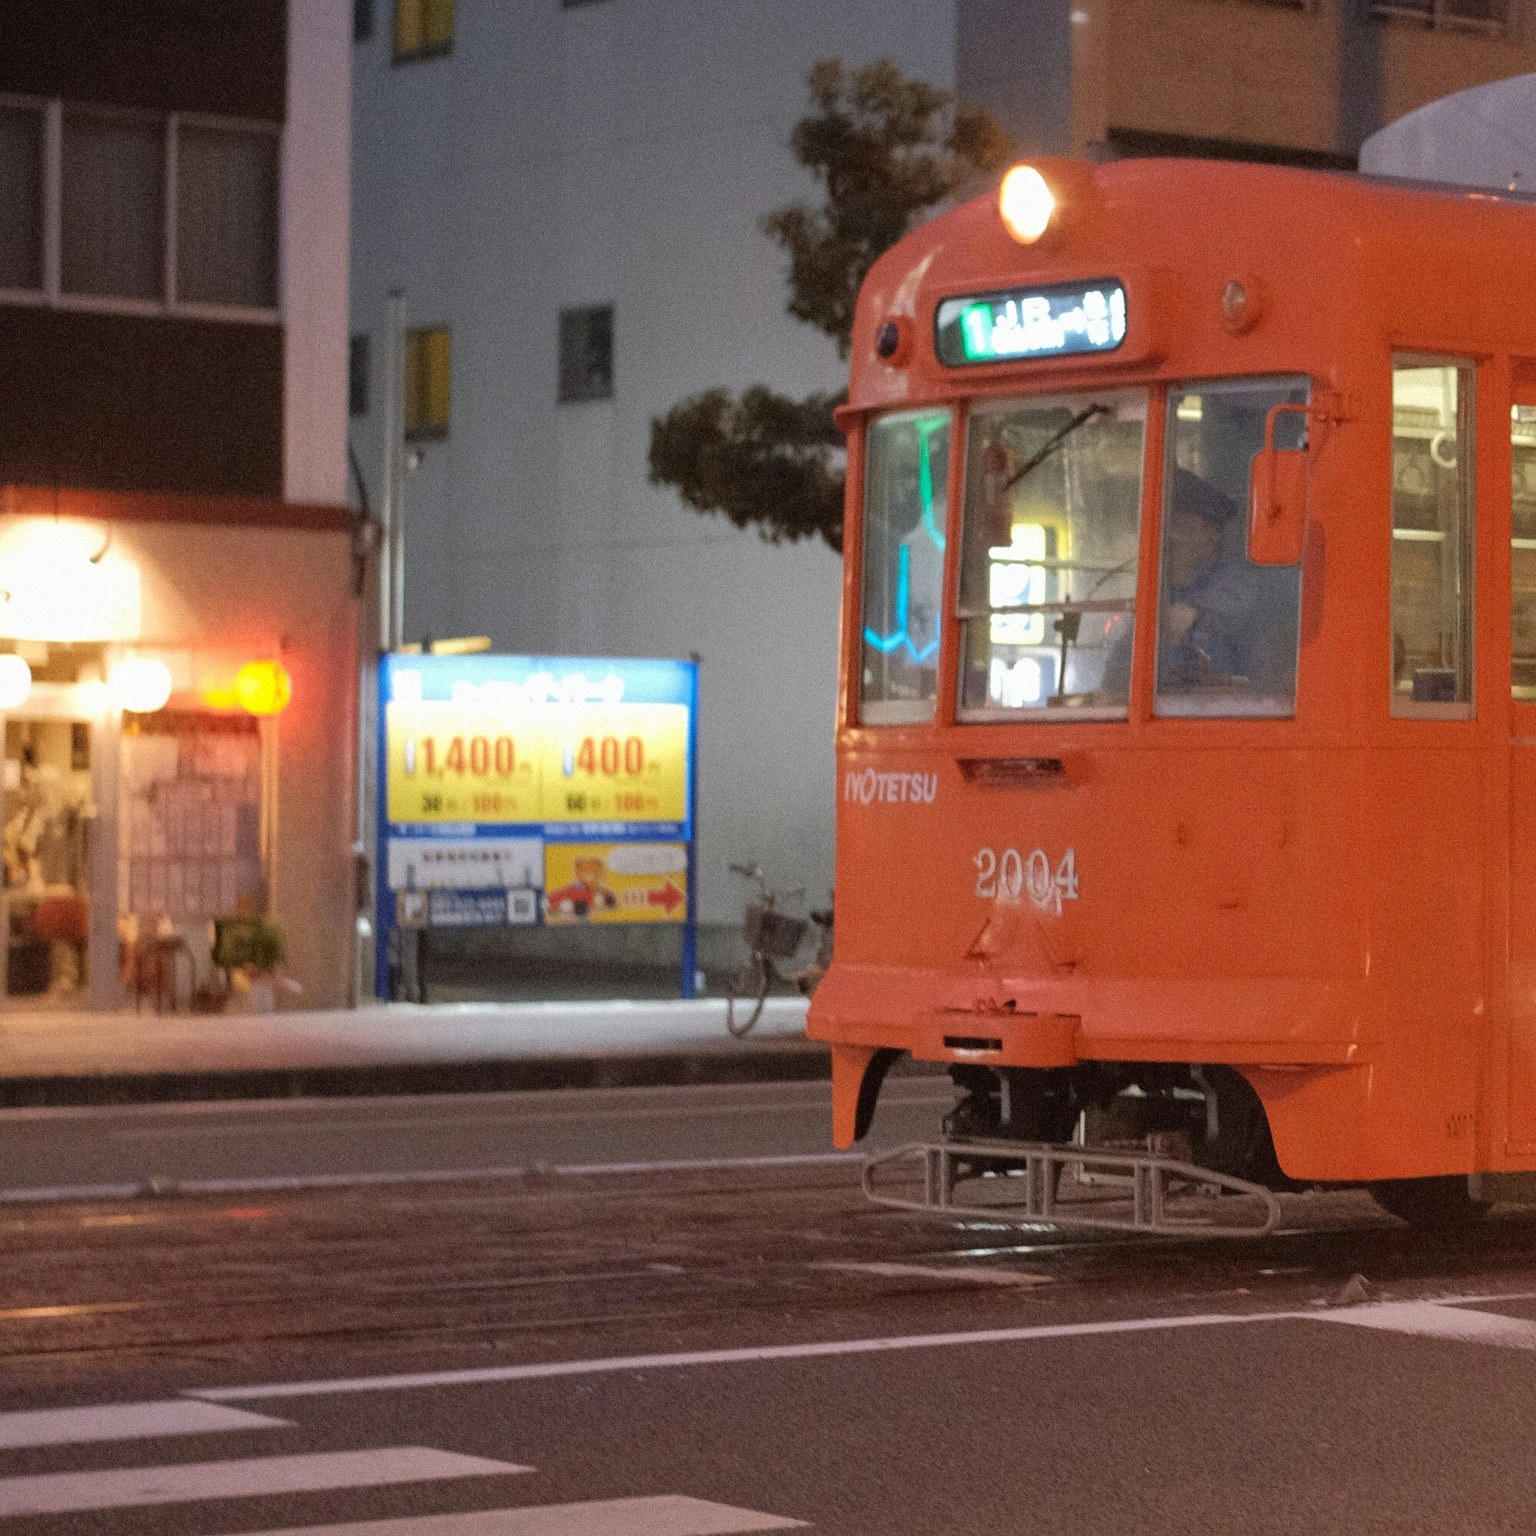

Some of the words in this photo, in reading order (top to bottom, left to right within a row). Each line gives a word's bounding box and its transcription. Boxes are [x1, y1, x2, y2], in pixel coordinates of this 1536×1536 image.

[966, 309, 986, 354] 1
[844, 768, 938, 805] IYOTETSU
[973, 847, 1080, 901] 2004
